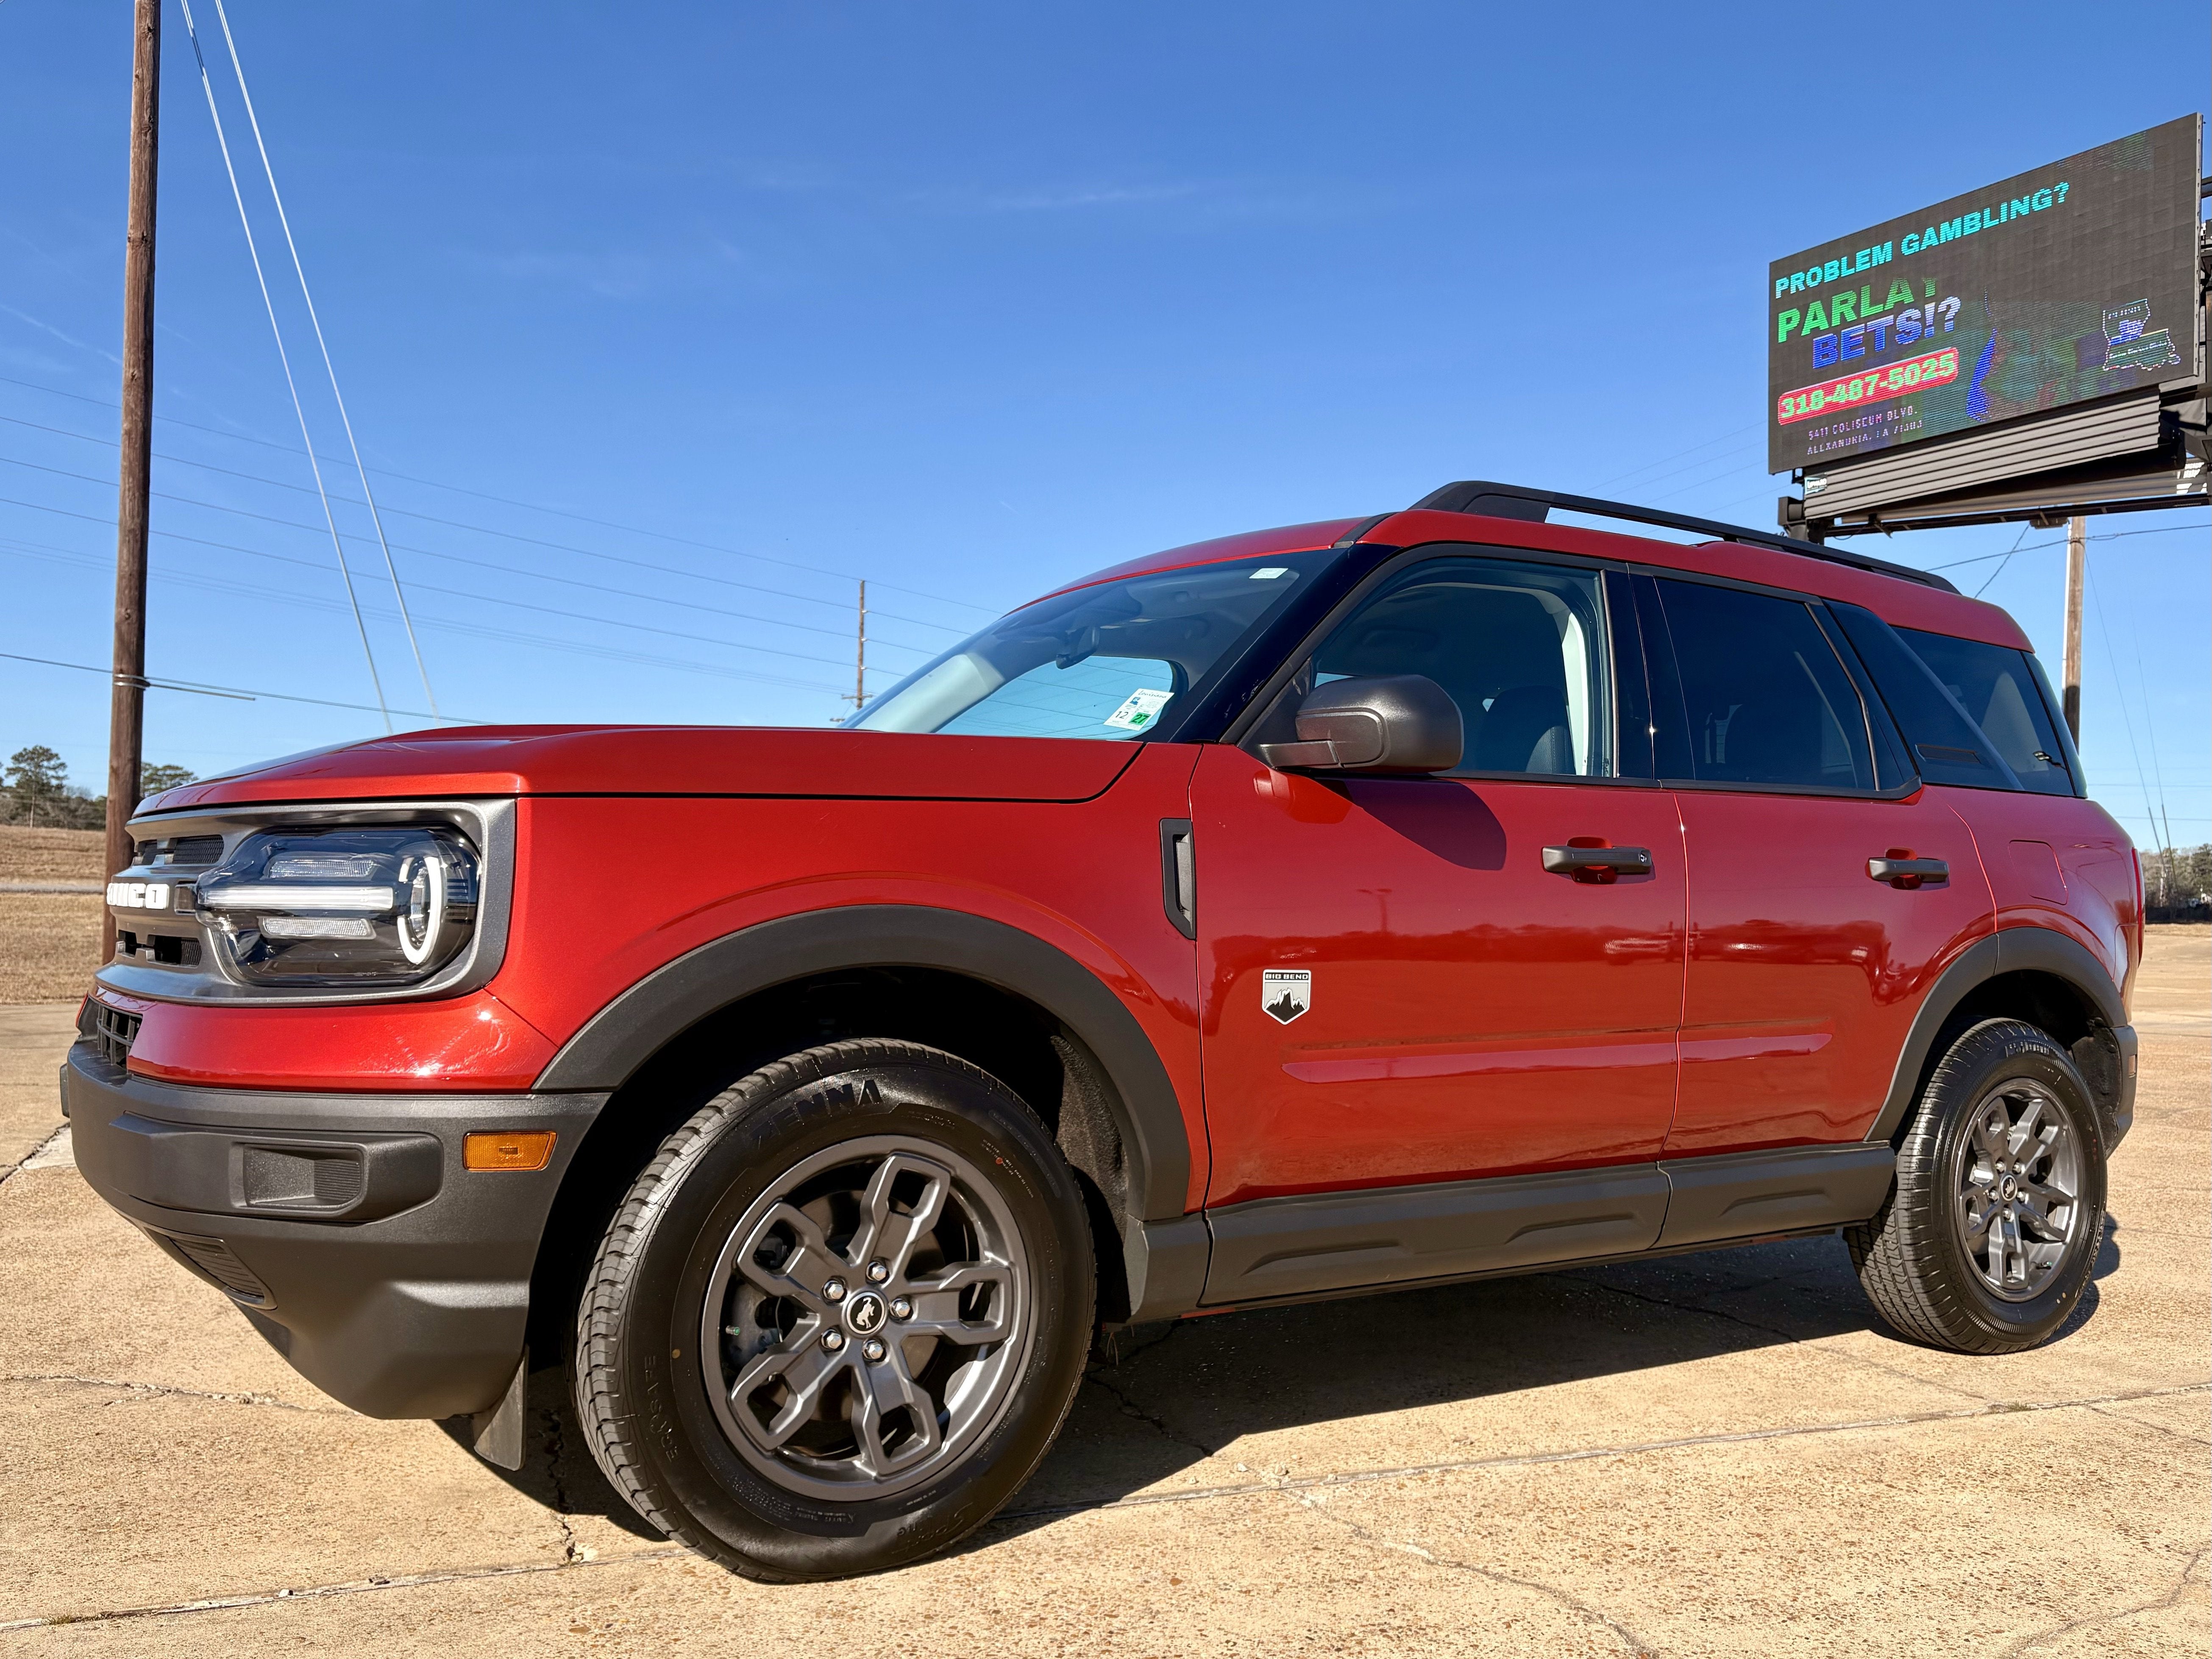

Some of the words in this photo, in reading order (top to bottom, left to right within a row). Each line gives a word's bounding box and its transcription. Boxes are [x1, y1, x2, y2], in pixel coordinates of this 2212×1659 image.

[1775, 241, 1892, 299] PROBLEM
[1900, 181, 2070, 256] GAMBLING?
[1812, 296, 1962, 368] BETS!?
[1781, 353, 1955, 418] 318-487-5025
[1115, 711, 1129, 719] 12
[1131, 714, 1150, 724] 27
